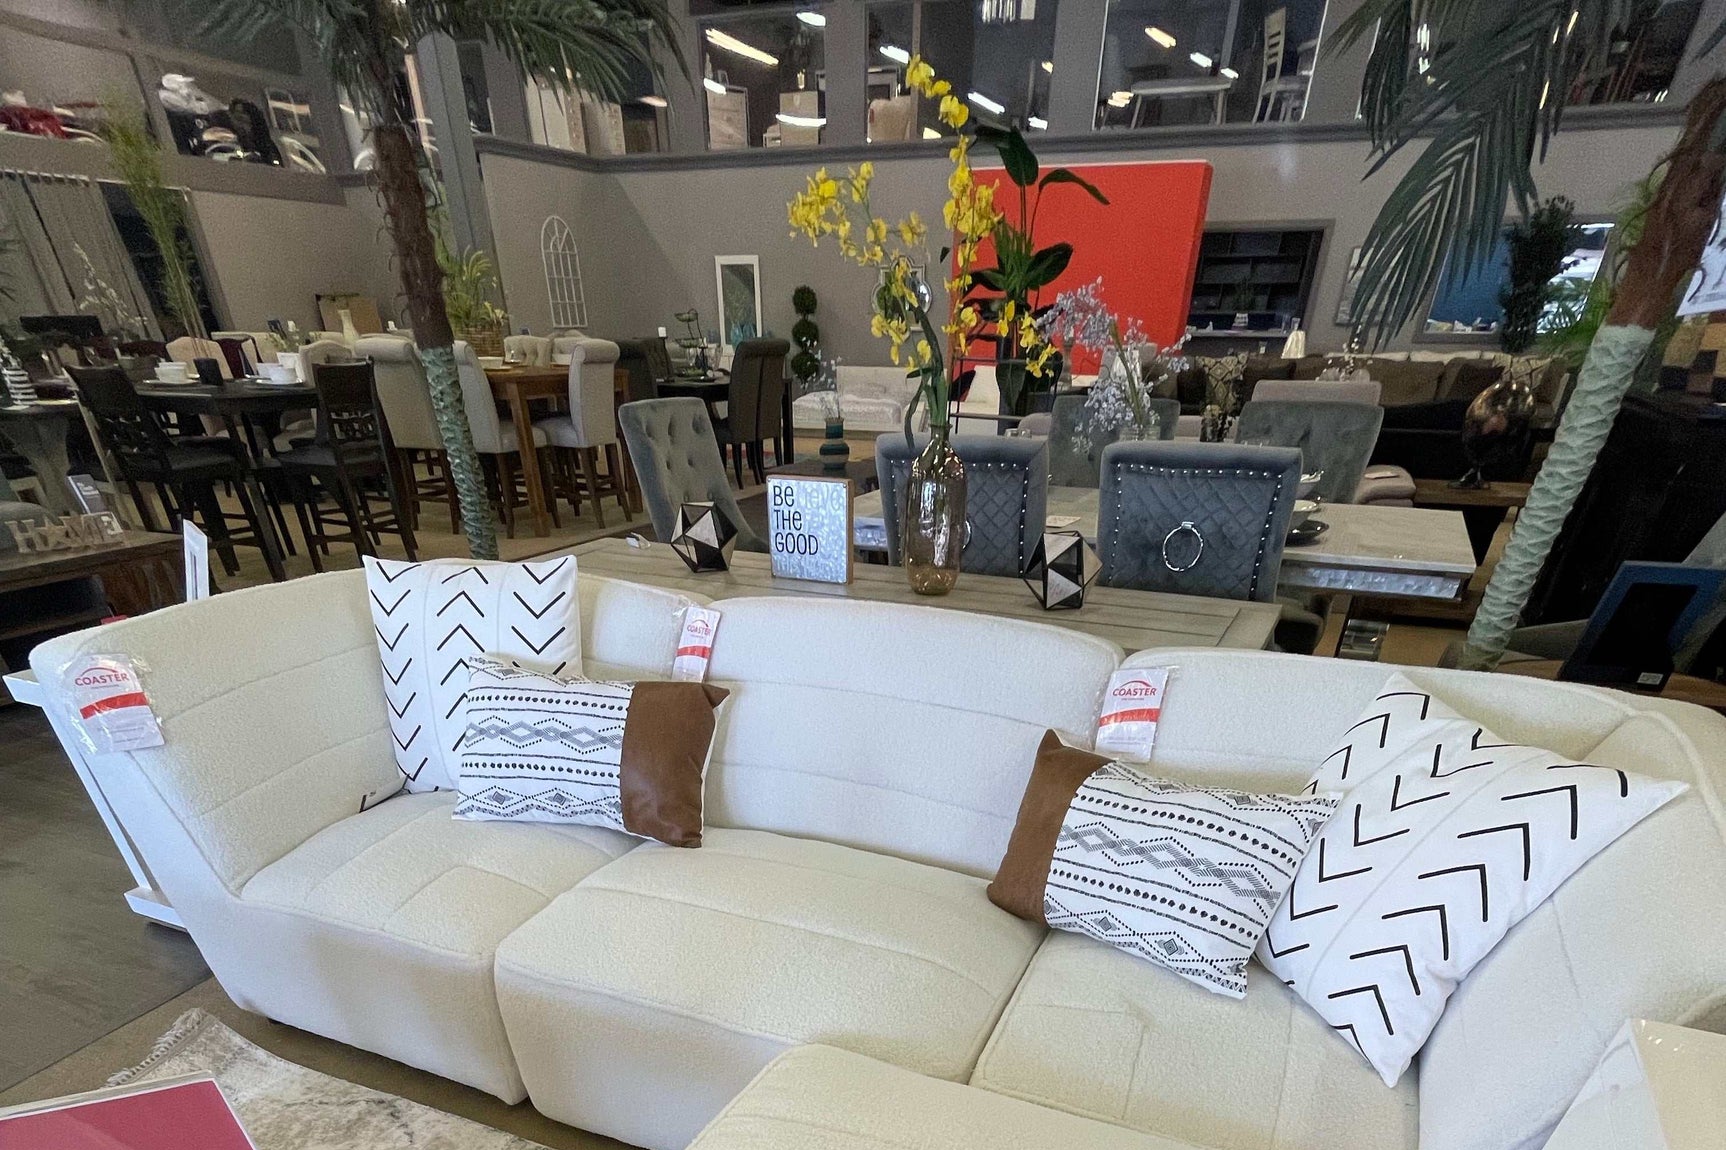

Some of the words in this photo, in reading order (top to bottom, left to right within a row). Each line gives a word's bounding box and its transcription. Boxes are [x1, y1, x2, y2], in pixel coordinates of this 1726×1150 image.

[775, 532, 819, 556] GOOD
[687, 624, 712, 637] COASTER
[75, 672, 130, 687] COASTER
[1112, 687, 1157, 697] COASTER
